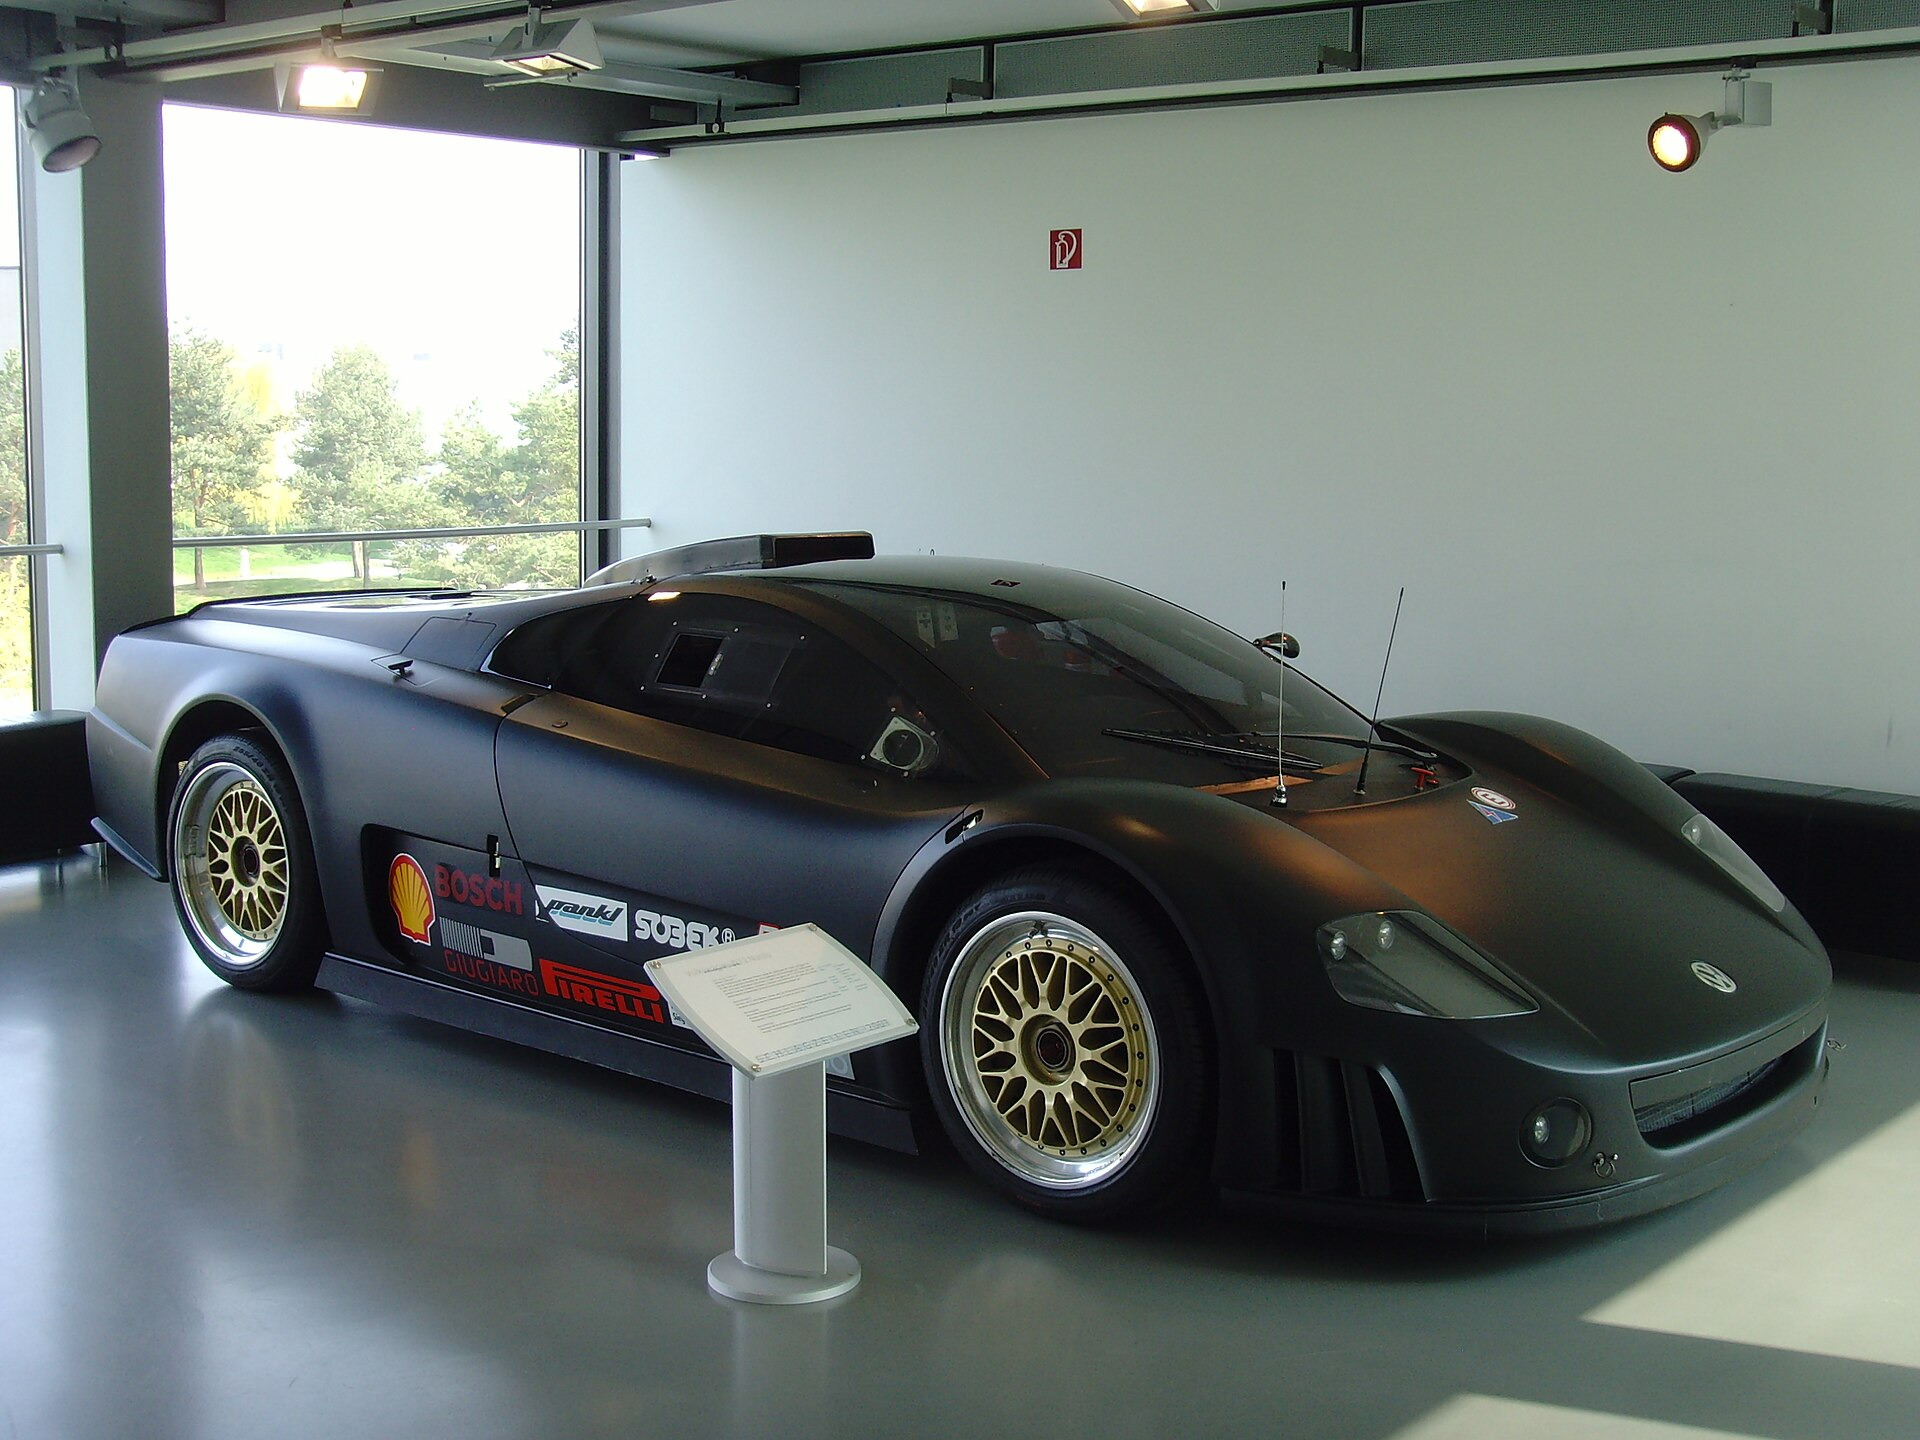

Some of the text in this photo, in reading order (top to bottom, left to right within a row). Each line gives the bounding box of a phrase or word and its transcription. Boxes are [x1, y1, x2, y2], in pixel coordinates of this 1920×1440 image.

[434, 864, 522, 915] BOSCH
[443, 949, 540, 997] GIUGIARO
[539, 958, 664, 1024] PIRELLI
